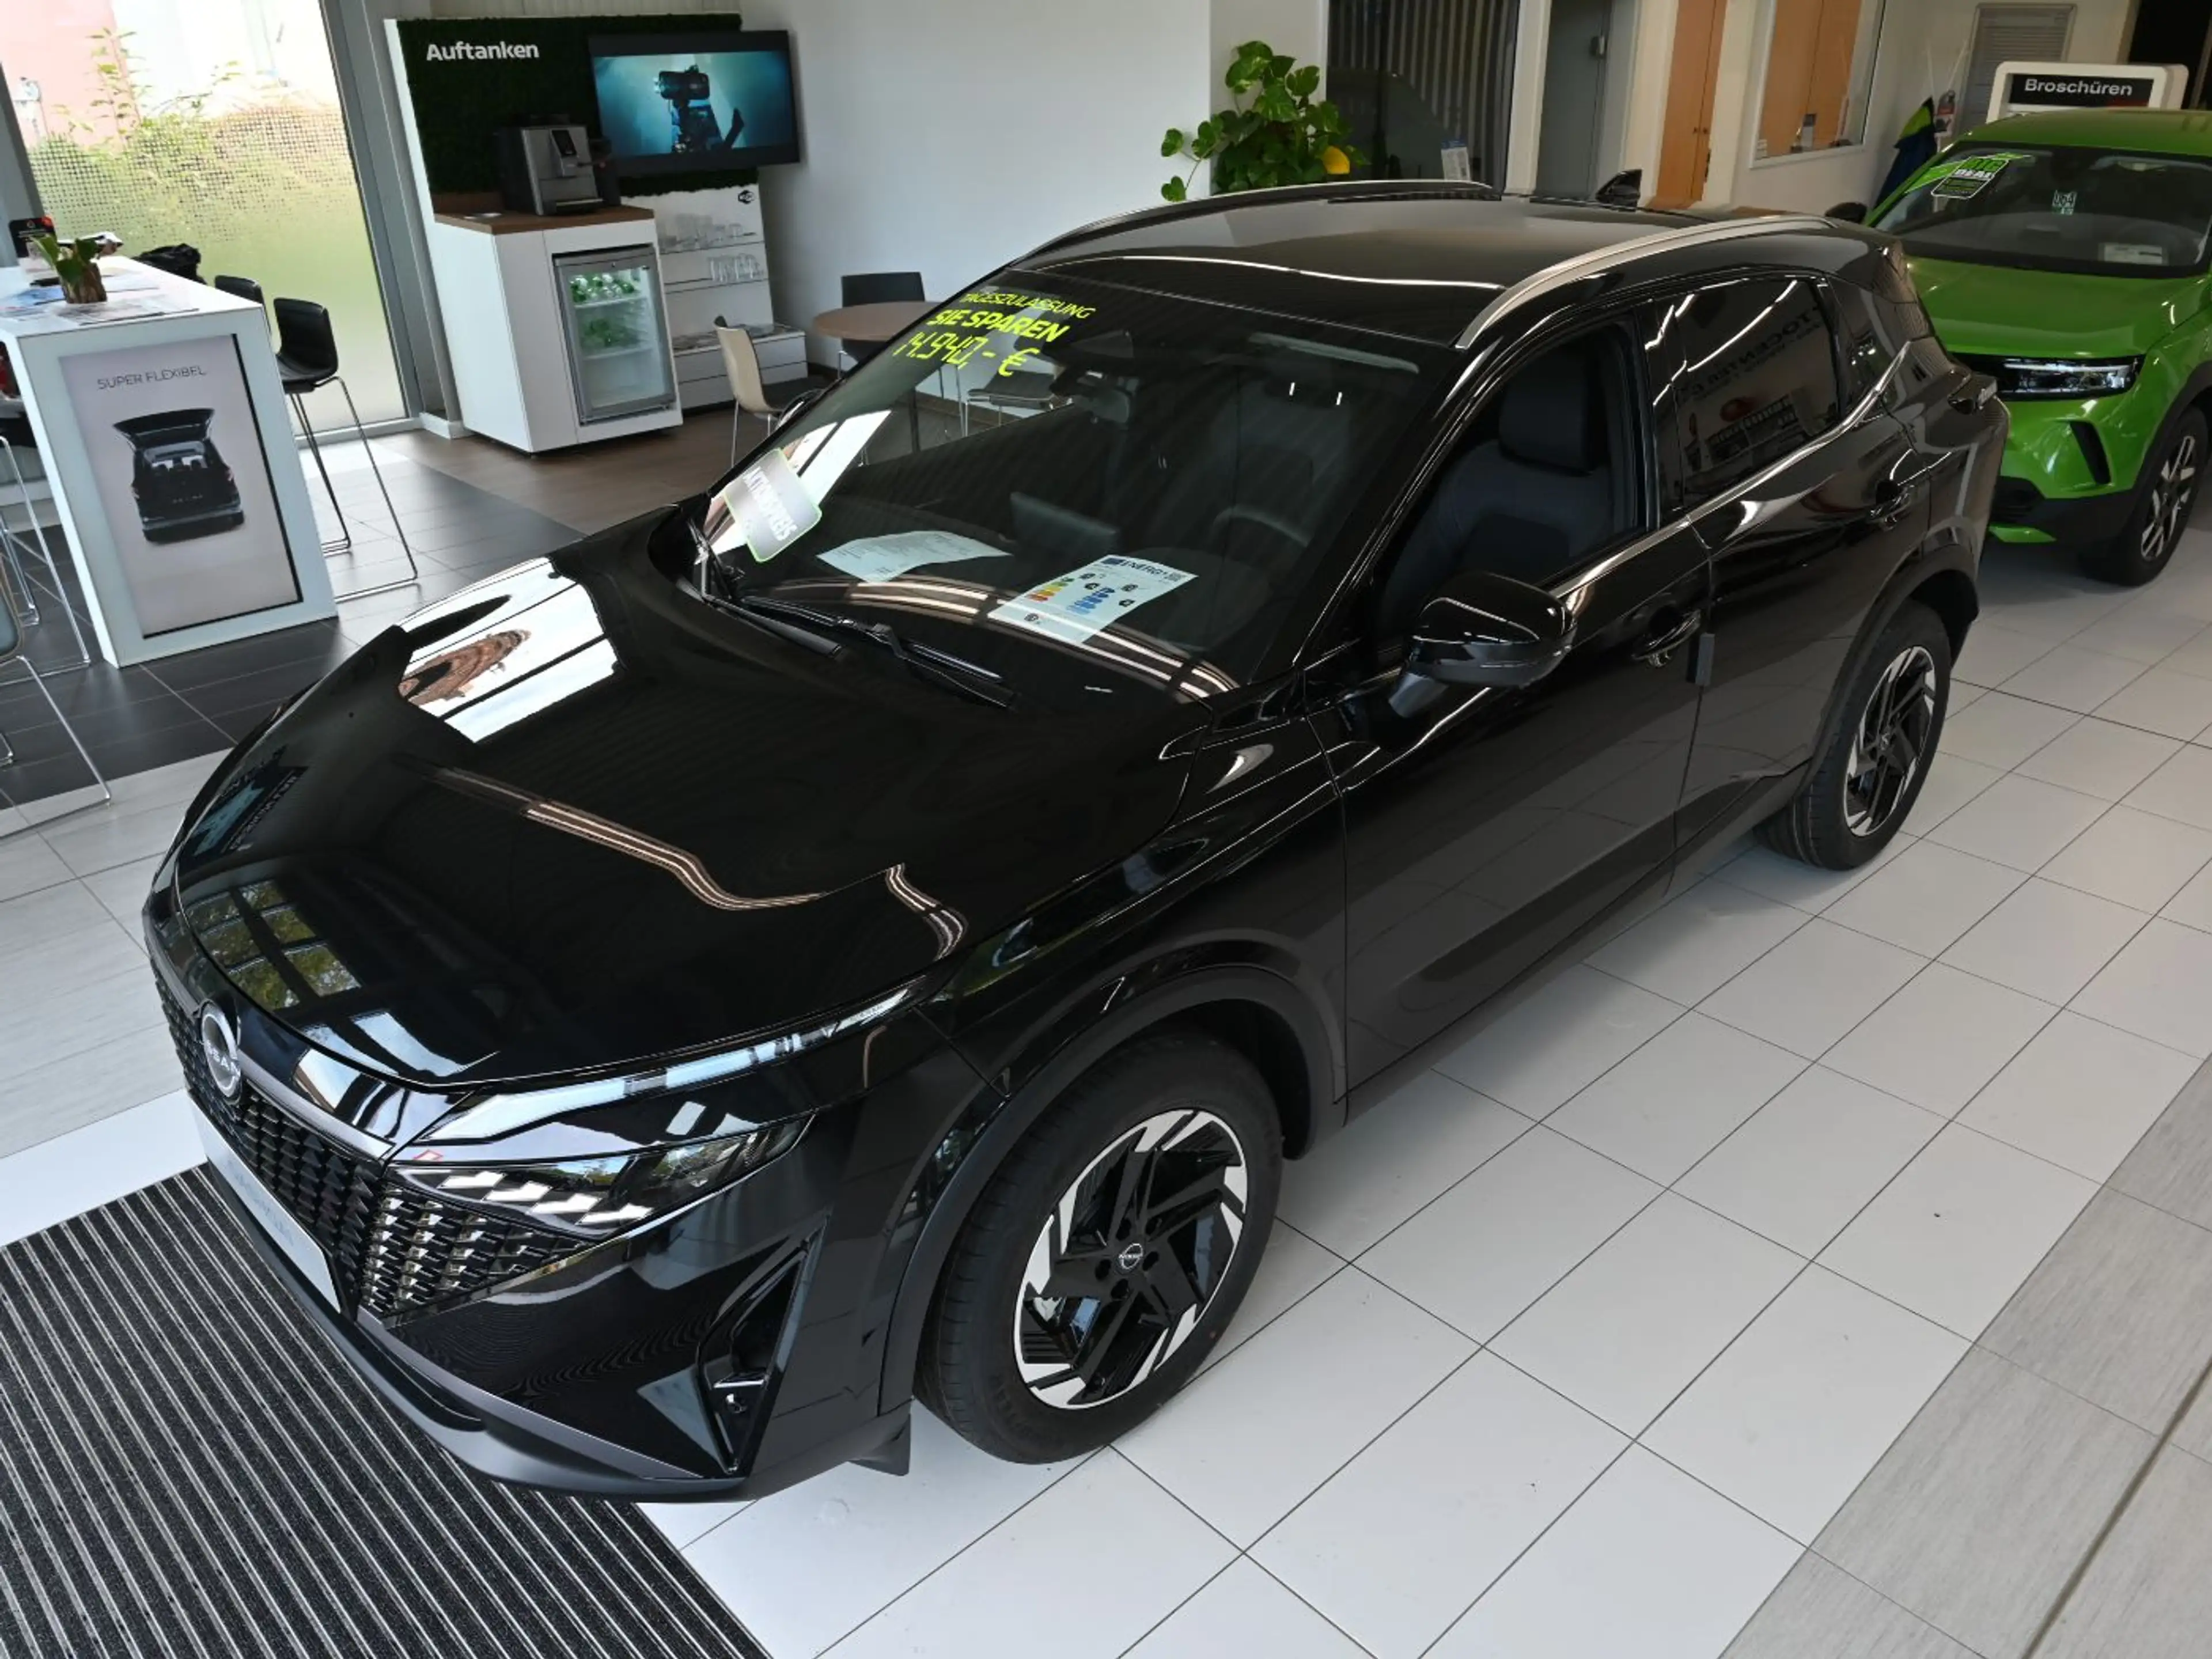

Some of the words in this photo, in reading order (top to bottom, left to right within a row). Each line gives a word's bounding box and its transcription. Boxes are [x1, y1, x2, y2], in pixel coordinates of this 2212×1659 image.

[426, 41, 539, 61] Auftanken
[2025, 78, 2132, 96] Broschüren
[927, 309, 972, 325] SIE
[961, 311, 1070, 342] SPAREN
[97, 374, 143, 389] SUPER
[145, 366, 207, 382] FLEXIBEL
